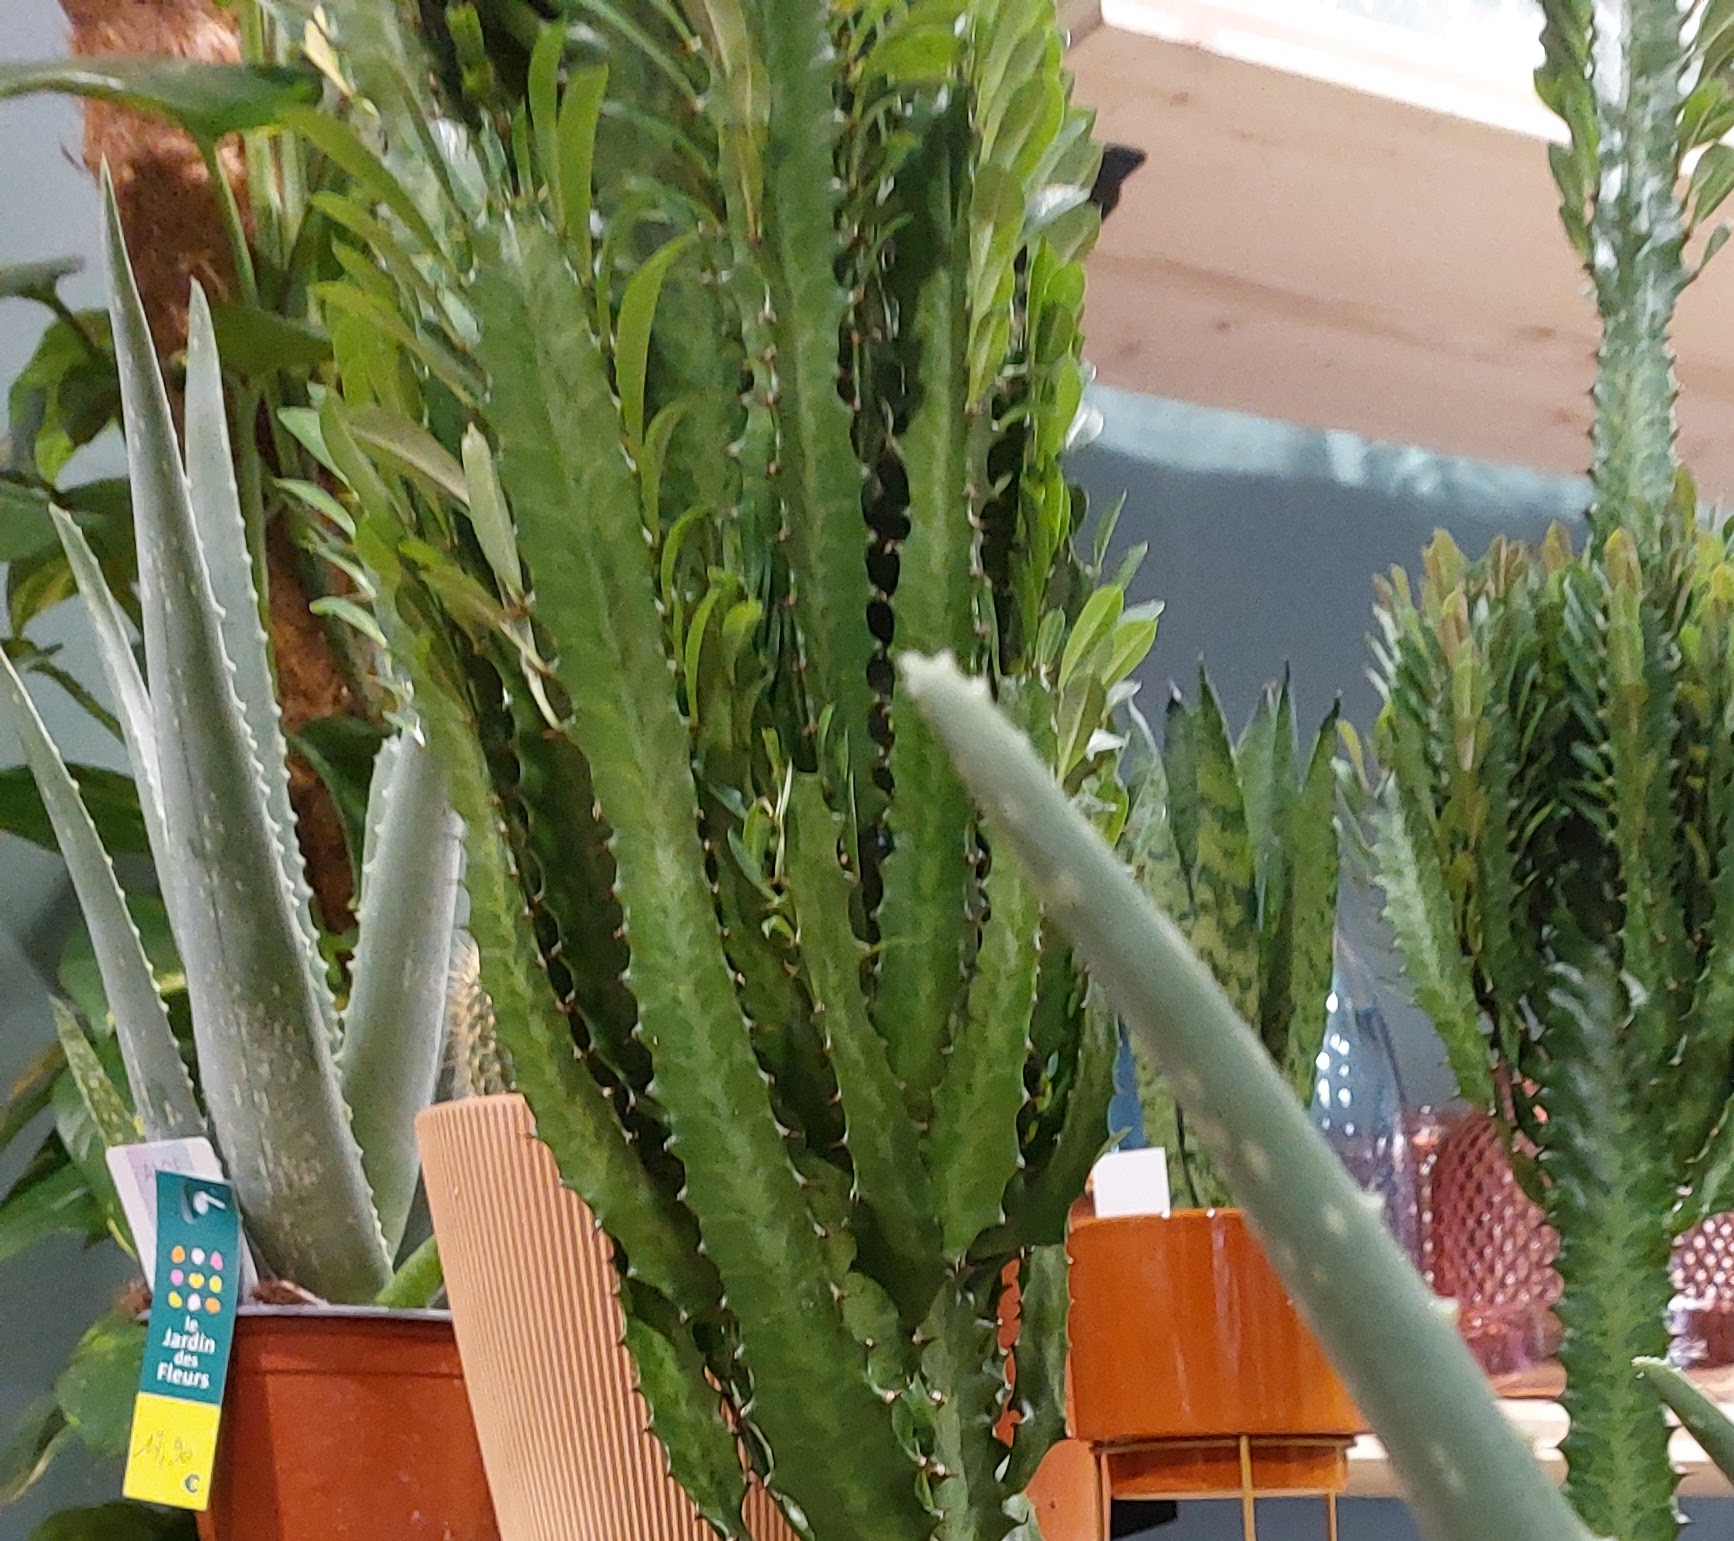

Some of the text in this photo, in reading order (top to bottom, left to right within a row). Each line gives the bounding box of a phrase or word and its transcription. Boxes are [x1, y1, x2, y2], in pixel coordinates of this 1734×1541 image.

[184, 1314, 199, 1333] le
[162, 1326, 216, 1355] Jardin
[173, 1349, 199, 1369] des
[156, 1361, 210, 1390] Fleurs
